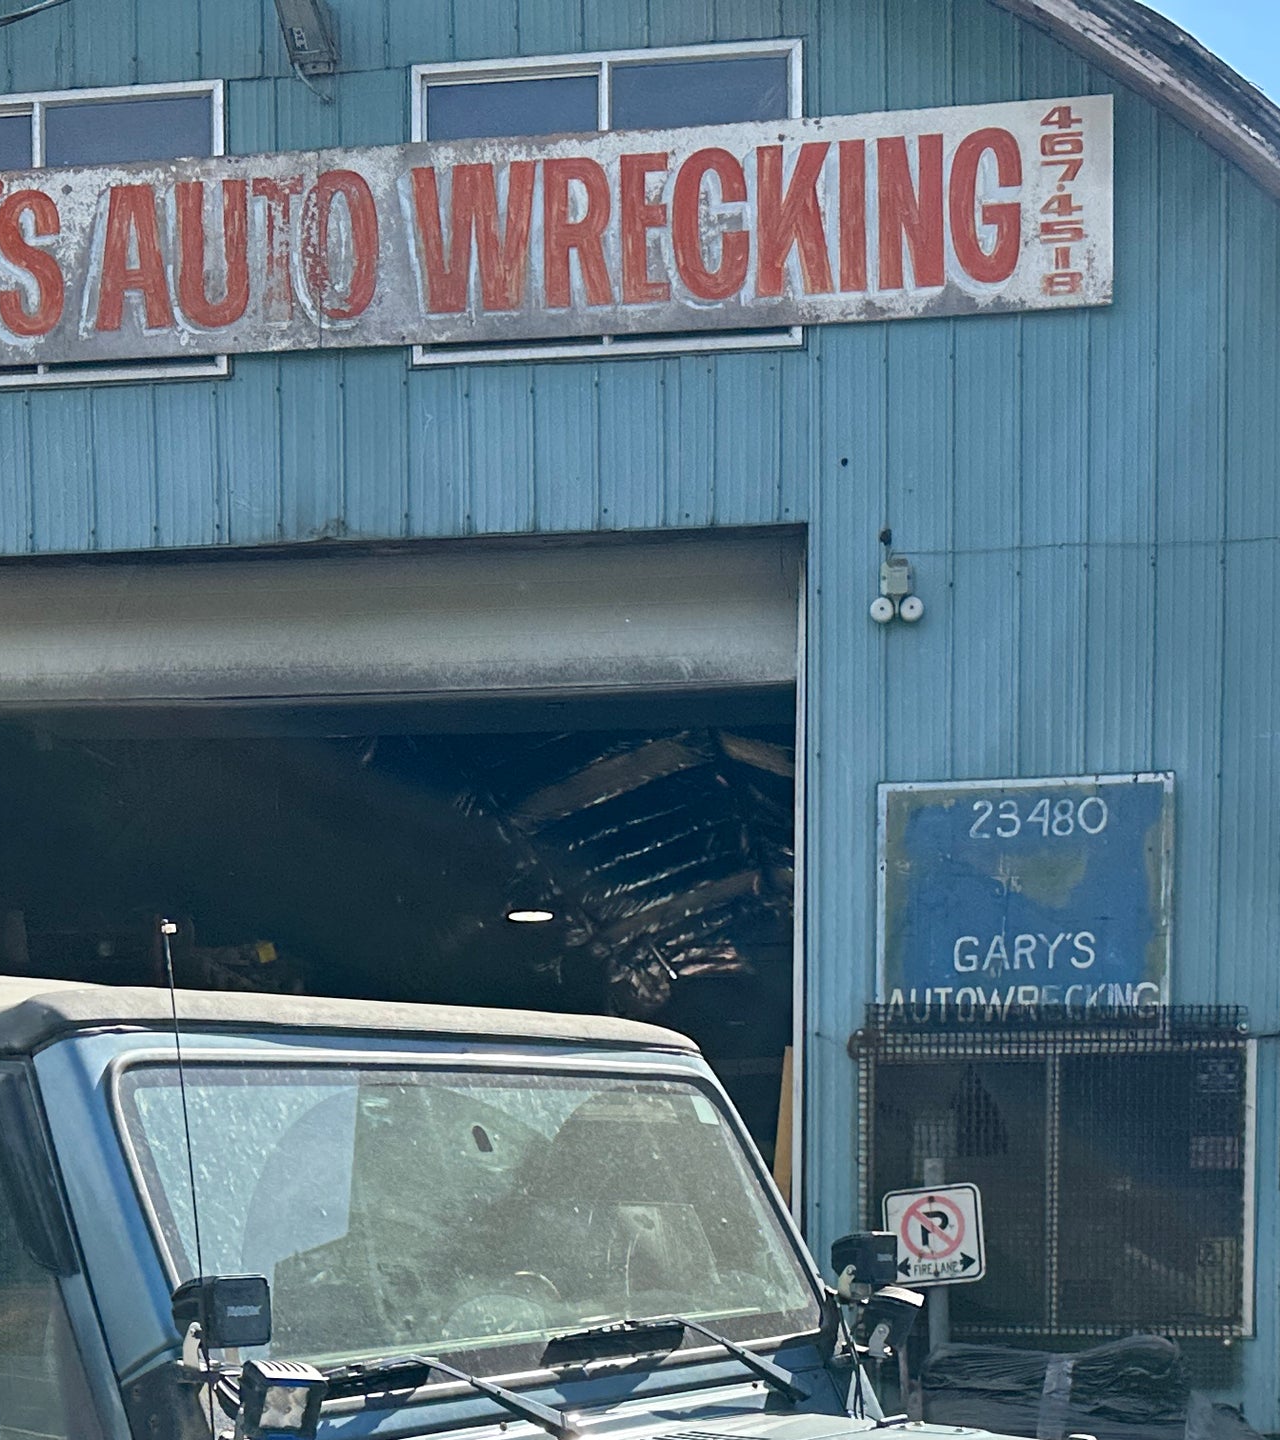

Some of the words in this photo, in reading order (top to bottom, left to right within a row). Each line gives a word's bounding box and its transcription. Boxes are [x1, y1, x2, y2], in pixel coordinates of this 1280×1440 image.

[95, 170, 380, 332] AUTO
[412, 127, 1022, 314] WRECKING
[969, 797, 1107, 839] 23480
[953, 932, 1096, 972] GARY'S
[914, 1264, 932, 1276] FIRE
